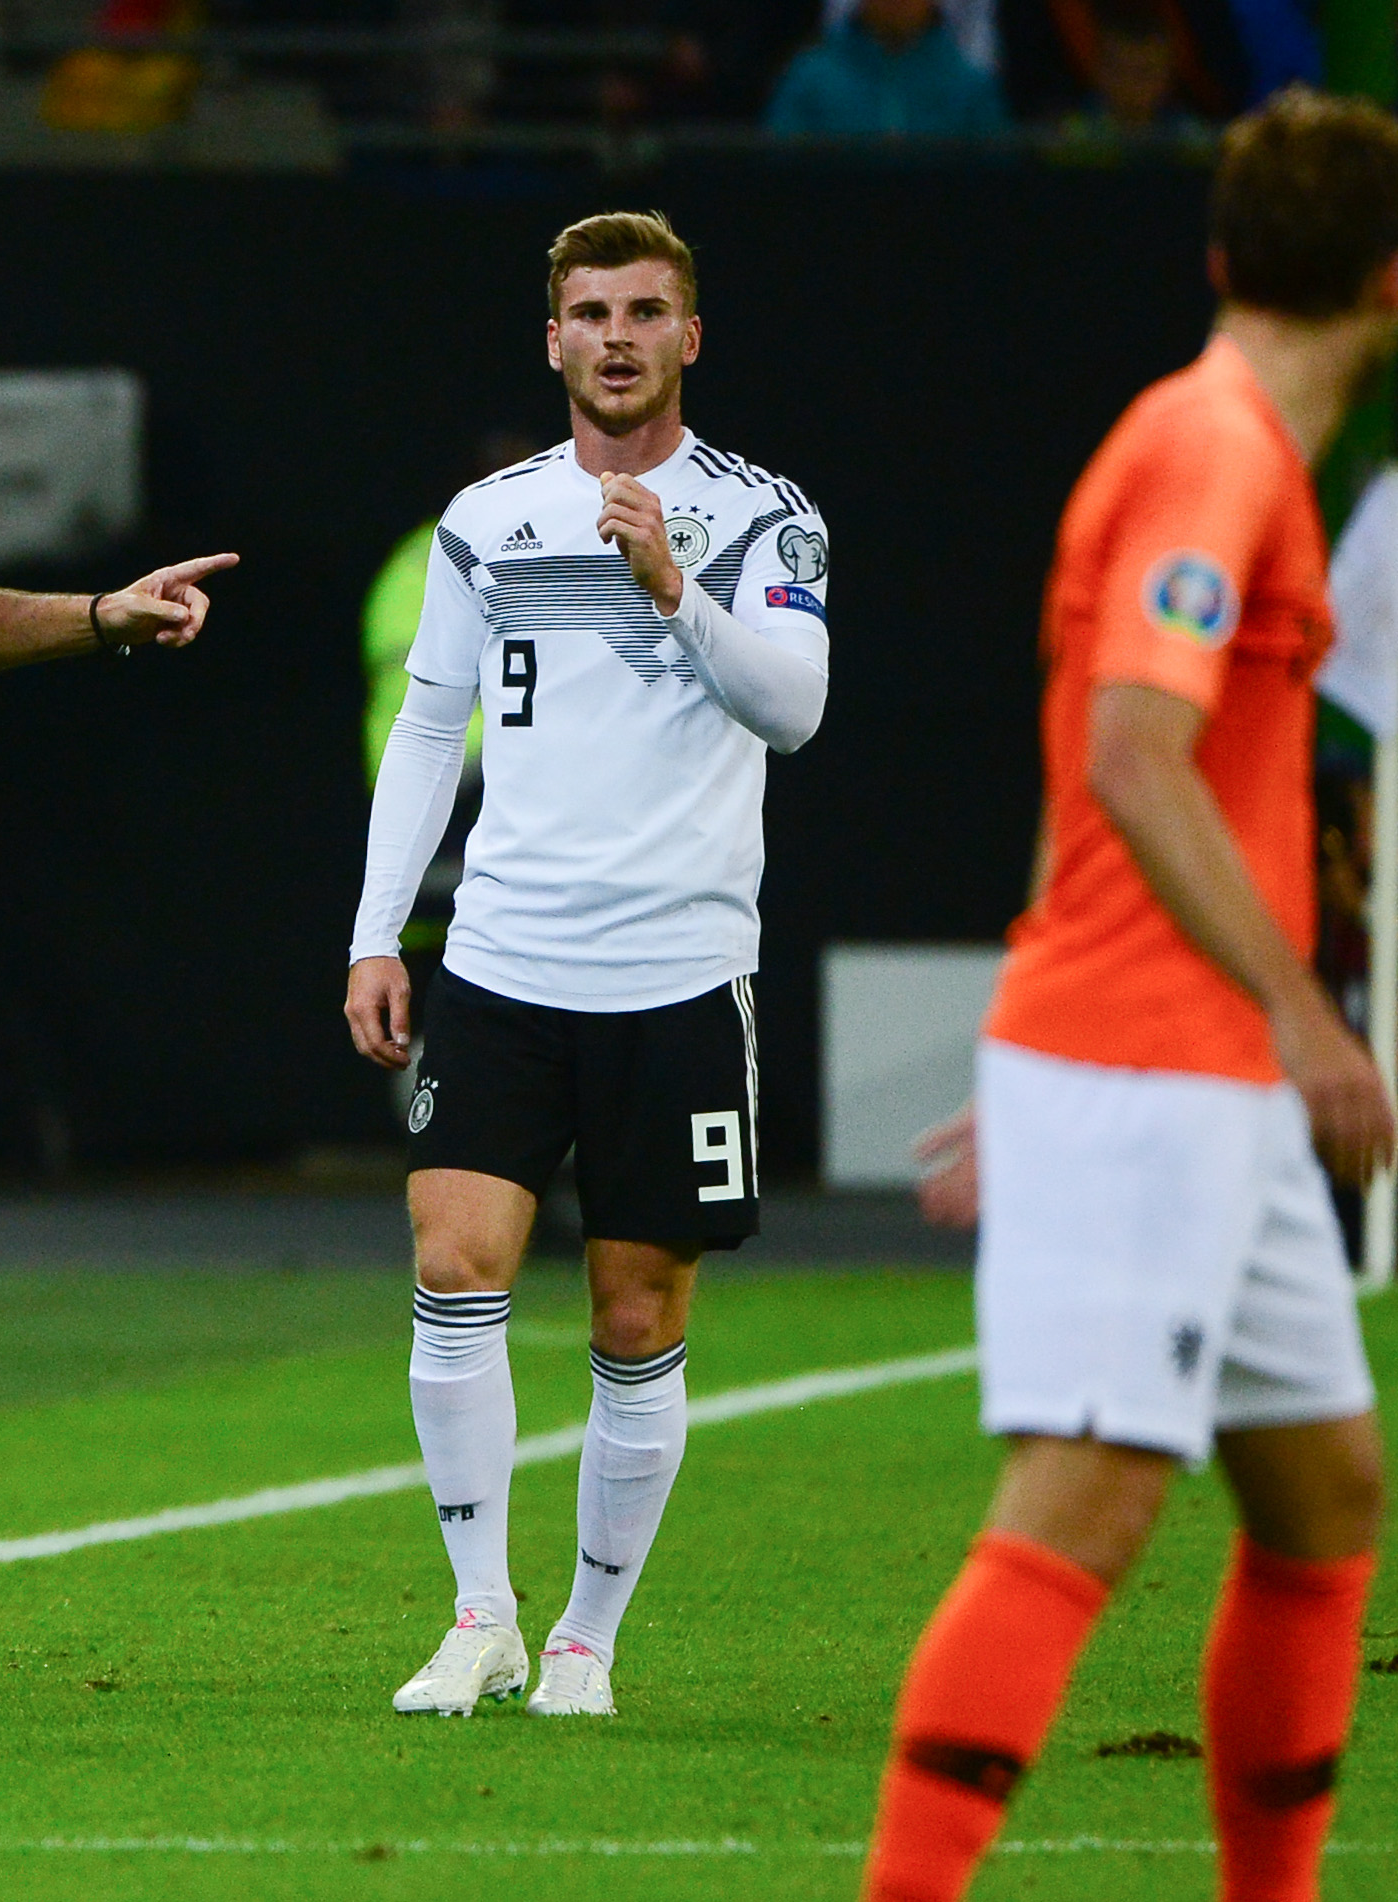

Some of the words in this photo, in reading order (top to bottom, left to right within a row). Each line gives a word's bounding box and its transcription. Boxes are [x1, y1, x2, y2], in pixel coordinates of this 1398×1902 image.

[501, 540, 543, 552] adidas
[501, 639, 537, 727] 9
[691, 1110, 745, 1203] 9
[438, 1503, 475, 1522] DFB
